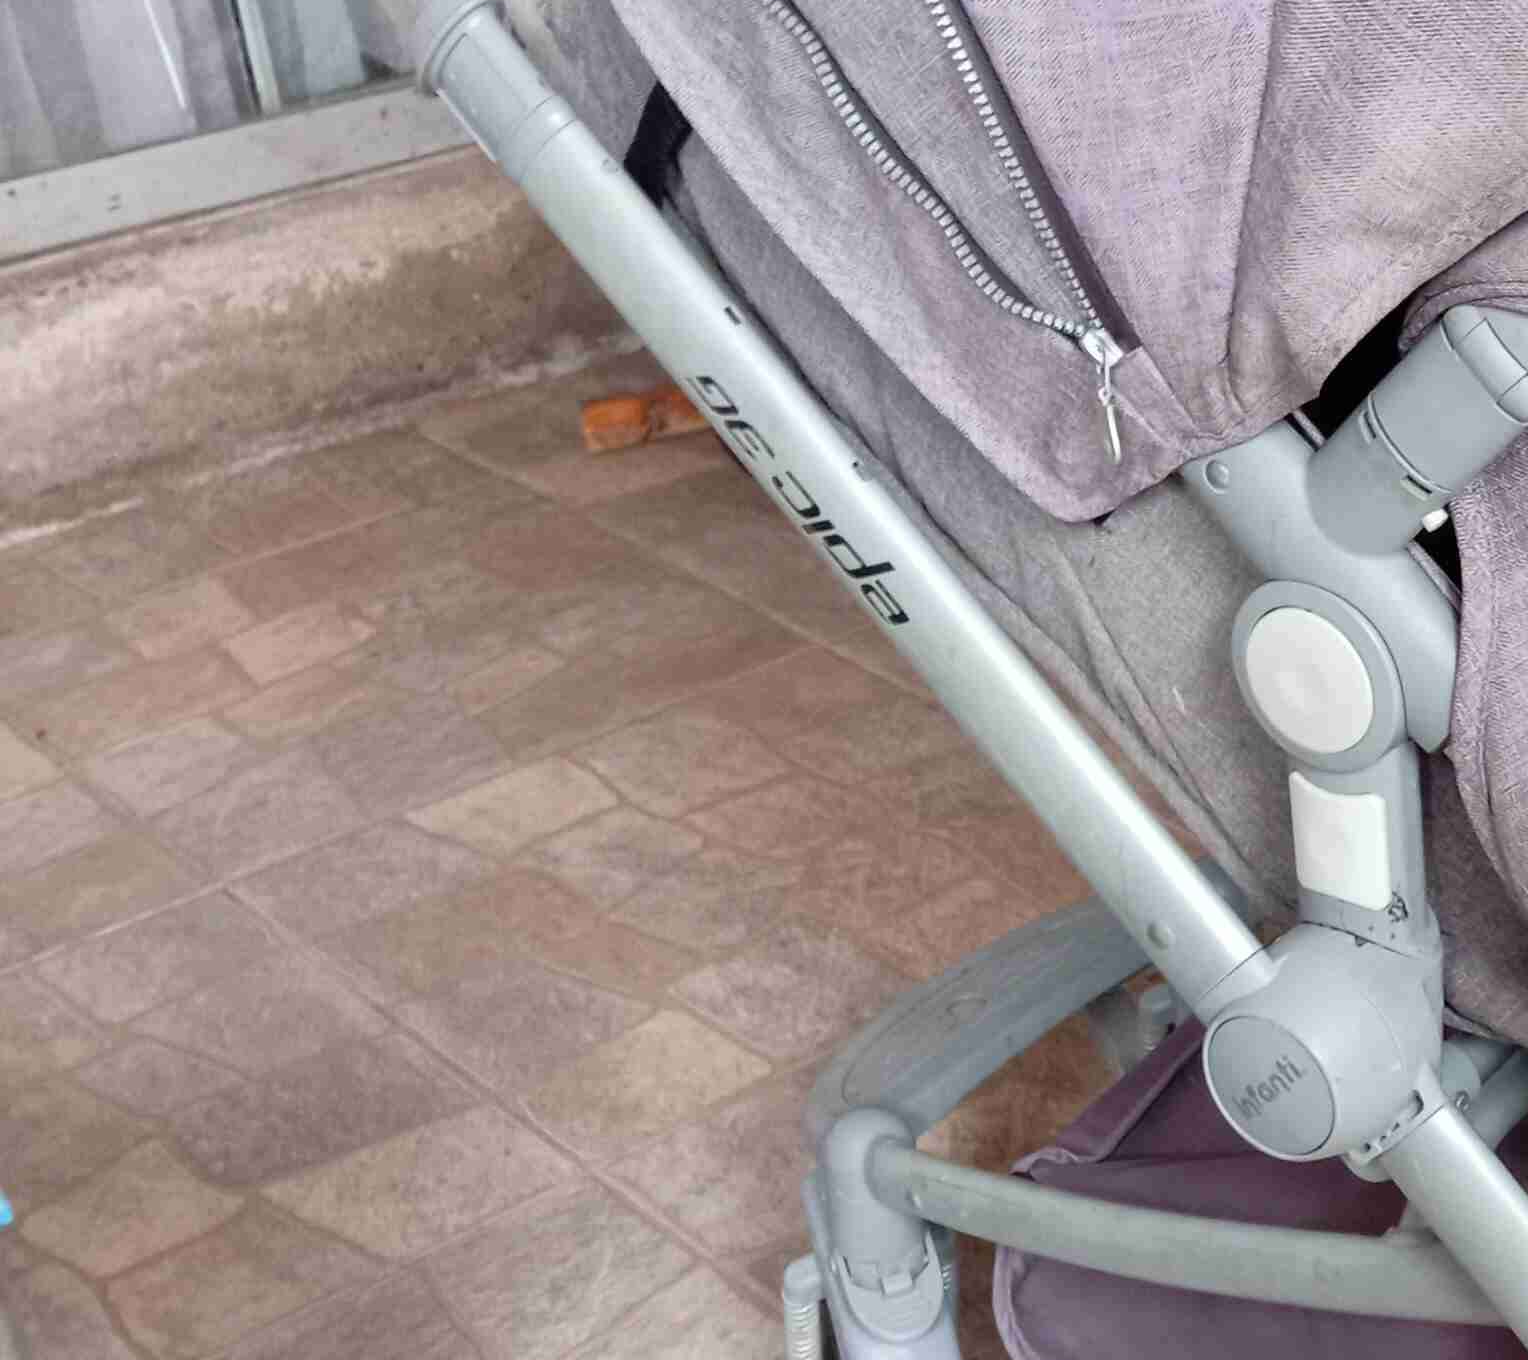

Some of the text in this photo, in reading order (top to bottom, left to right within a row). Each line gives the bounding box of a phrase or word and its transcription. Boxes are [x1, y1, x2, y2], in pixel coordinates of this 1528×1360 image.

[681, 376, 909, 625] epic 3G
[1232, 1055, 1302, 1119] infanti
